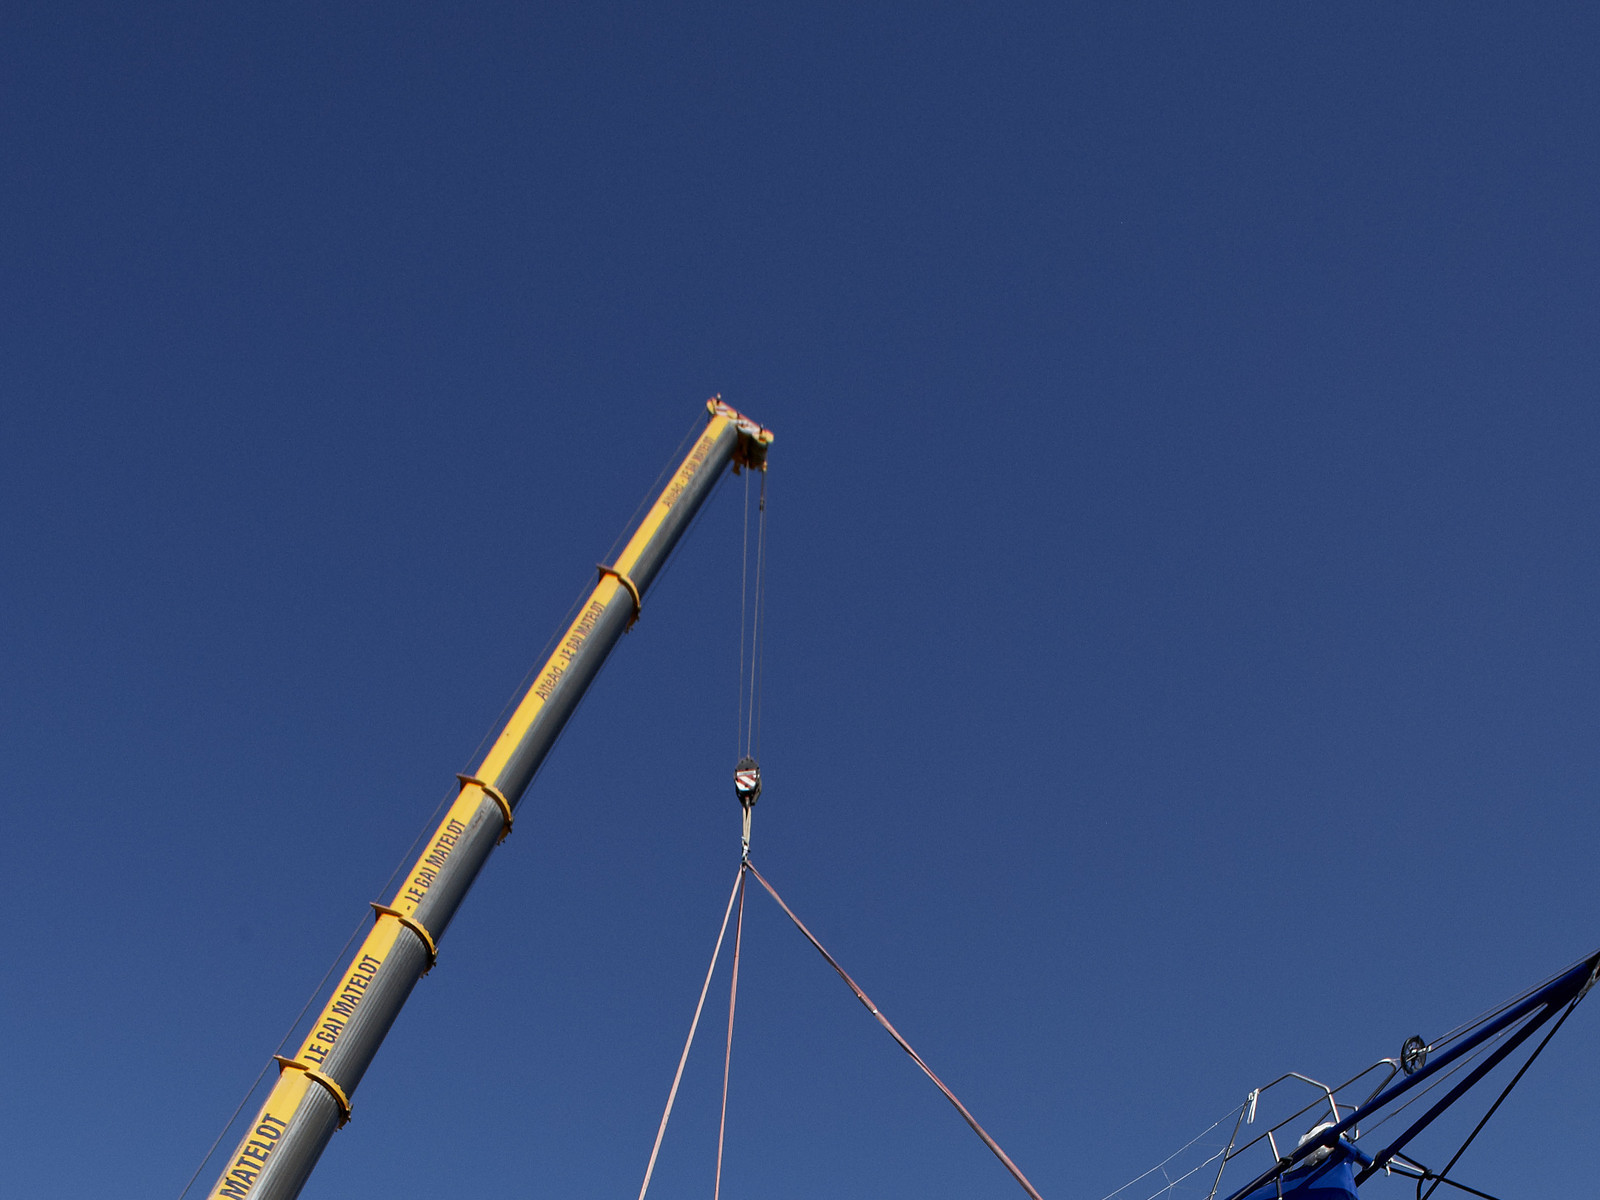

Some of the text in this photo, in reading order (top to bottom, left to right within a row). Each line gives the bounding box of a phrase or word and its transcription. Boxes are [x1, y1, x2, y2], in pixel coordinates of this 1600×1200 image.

[573, 600, 606, 637] MATELOT
[424, 818, 466, 869] MATELOT
[404, 887, 425, 905] LE
[414, 866, 438, 890] GAI
[304, 954, 381, 1065] LE GAI MATELOT
